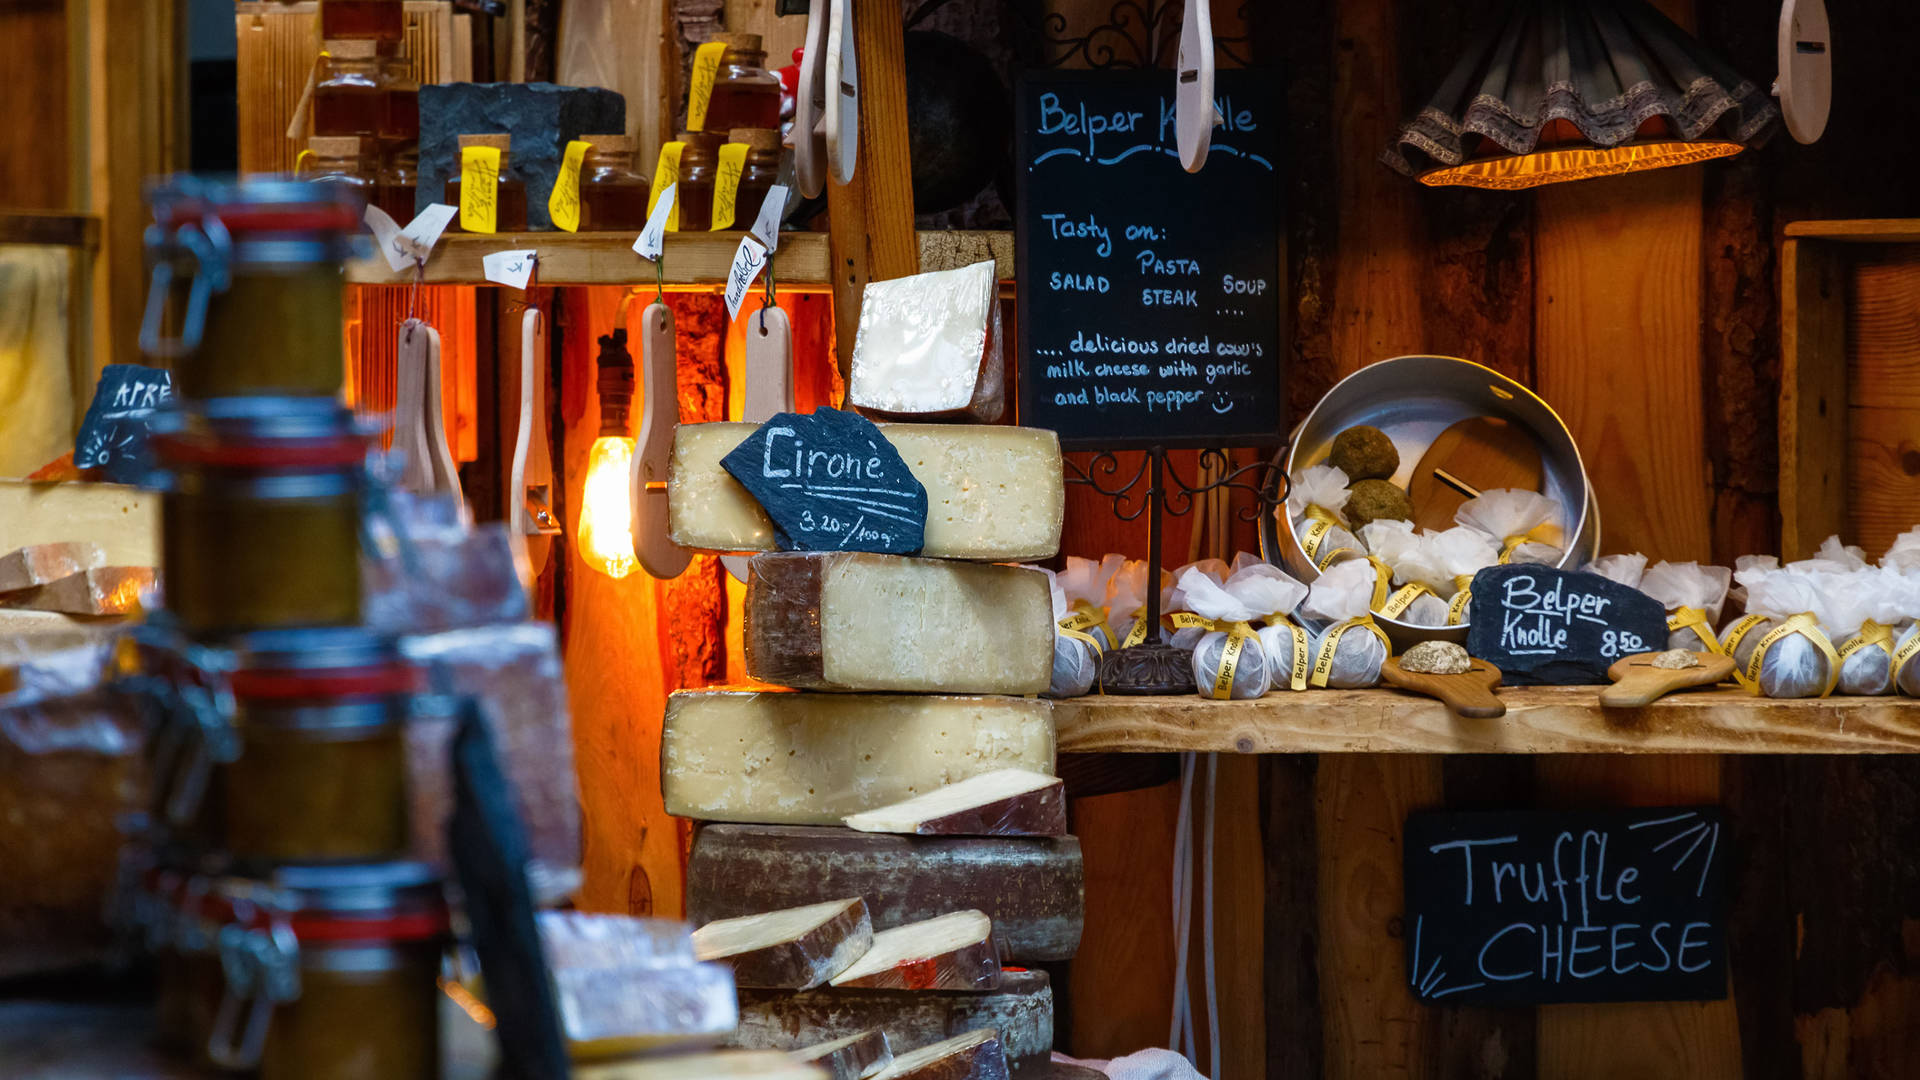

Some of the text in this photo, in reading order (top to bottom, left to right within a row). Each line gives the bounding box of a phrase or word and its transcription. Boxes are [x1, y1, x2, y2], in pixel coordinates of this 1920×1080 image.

[1038, 92, 1144, 156] Belper
[1042, 213, 1167, 258] Tasty on:
[1136, 250, 1201, 276] PASTA
[1050, 272, 1110, 293] SALAD
[1142, 288, 1199, 308] STEAK
[1223, 274, 1267, 296] SOUP
[1069, 331, 1160, 354] delicious
[1165, 335, 1210, 355] dried
[1047, 359, 1252, 384] milk cheese with garlic
[1054, 385, 1205, 413] and black pepper
[1387, 590, 1412, 613] Belper
[1501, 575, 1612, 626] Belper
[1501, 609, 1568, 649] Knolle
[1218, 635, 1242, 691] Belper Knolle
[1295, 647, 1307, 679] Belper
[1316, 641, 1333, 674] Belper
[1748, 627, 1787, 682] Belper Knolle
[1837, 638, 1865, 659] Knolle
[1429, 830, 1642, 925] Truffle
[1478, 921, 1712, 984] CHEESE
